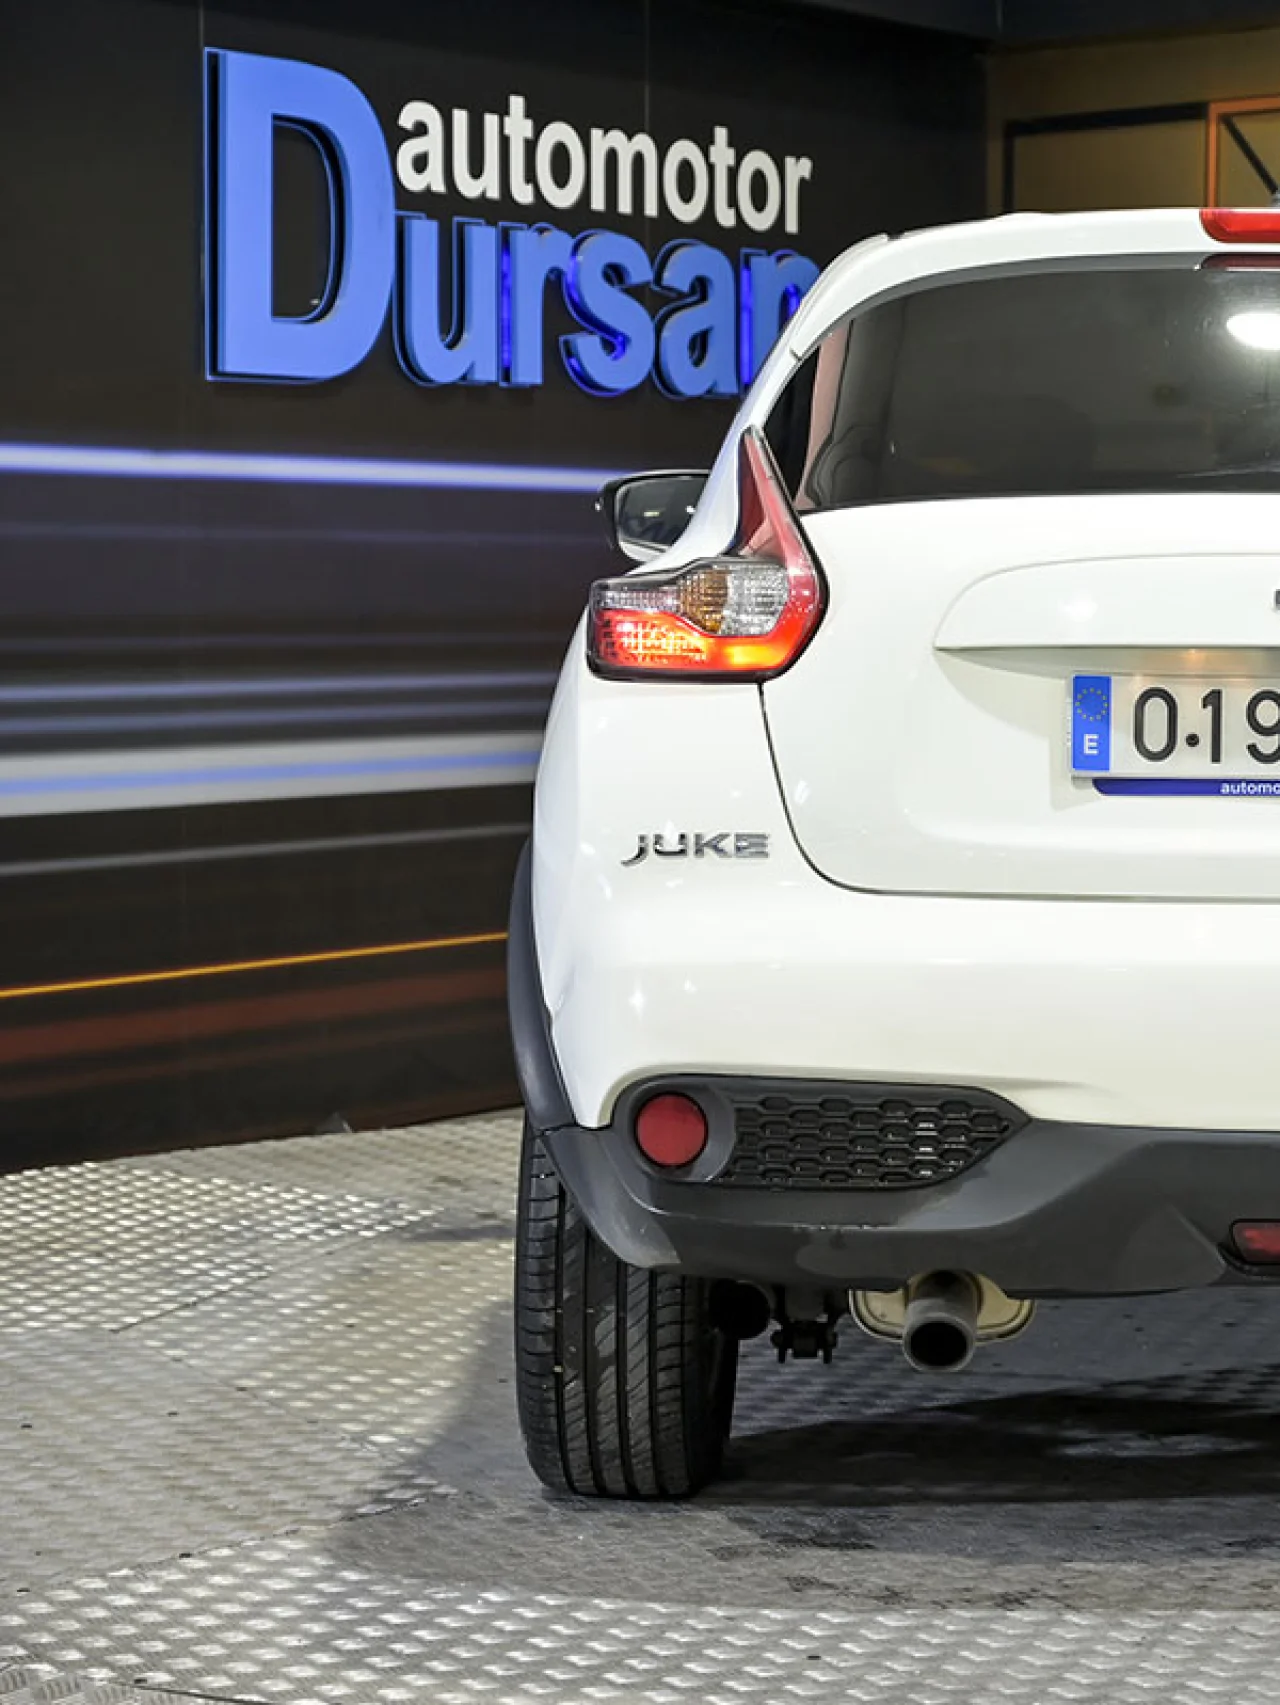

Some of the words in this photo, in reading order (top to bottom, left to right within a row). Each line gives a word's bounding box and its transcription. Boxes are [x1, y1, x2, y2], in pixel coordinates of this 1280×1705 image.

[396, 95, 812, 233] automotor
[1083, 733, 1099, 755] E
[621, 832, 771, 867] JUKE
